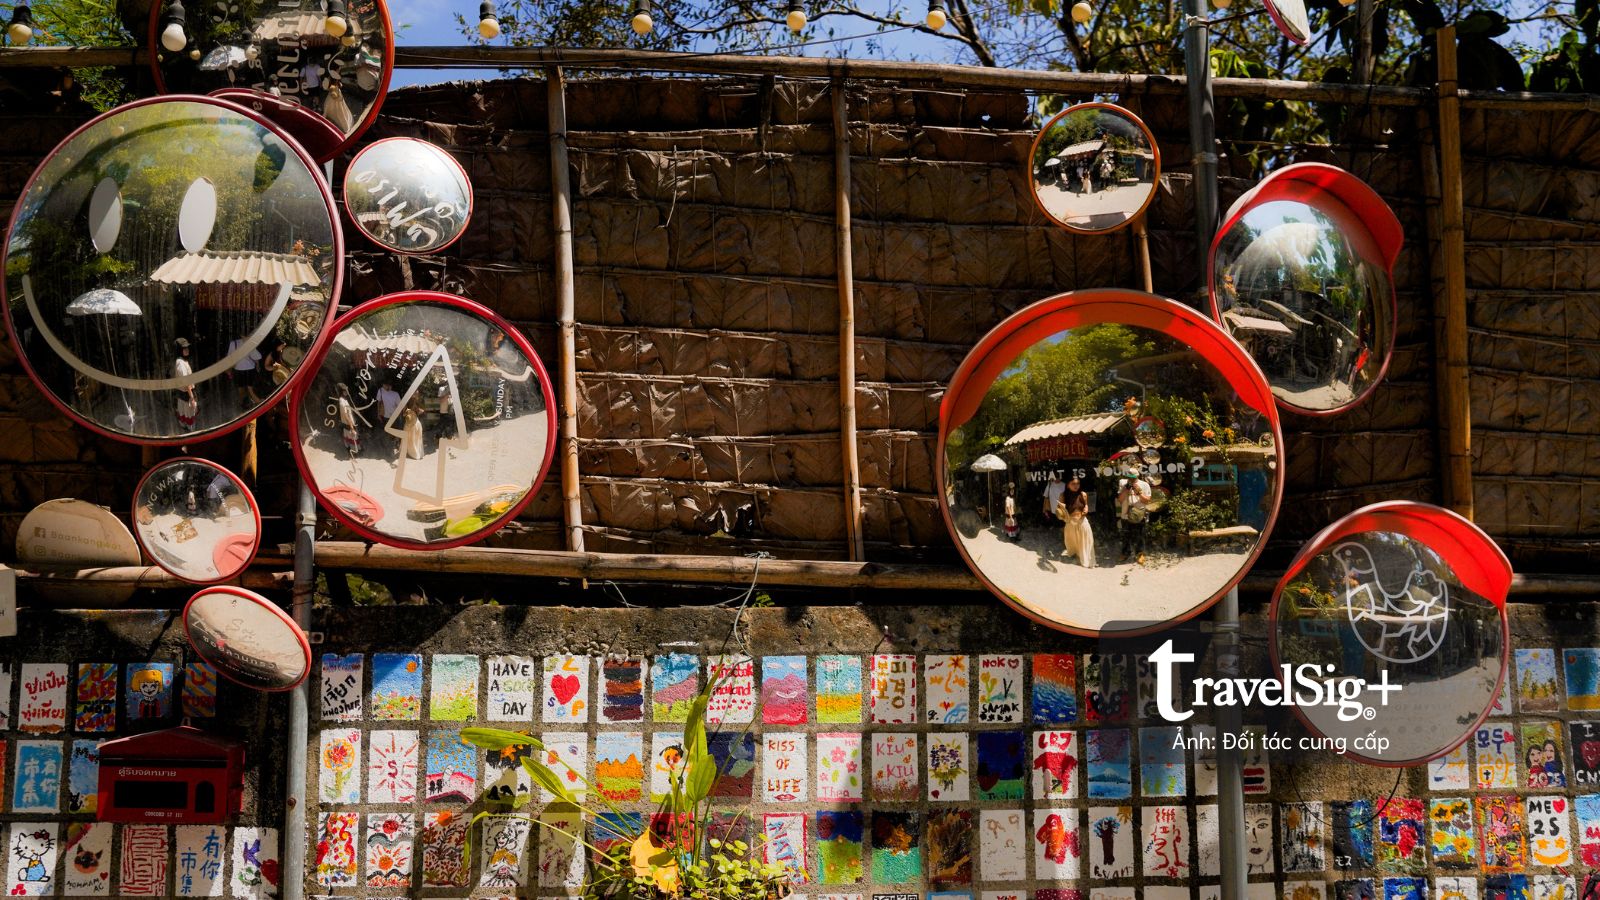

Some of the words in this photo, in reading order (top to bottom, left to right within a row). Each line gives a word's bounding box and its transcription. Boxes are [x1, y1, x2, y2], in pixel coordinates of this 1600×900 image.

[495, 378, 505, 413] SUNDAY
[1026, 469, 1064, 482] WHAT
[1072, 468, 1086, 479] IS
[1094, 465, 1132, 478] YOUR
[1140, 462, 1185, 474] COLOR
[982, 656, 1005, 668] NOK
[493, 663, 530, 677] HAVE
[491, 680, 499, 691] A
[502, 702, 527, 715] DAY
[768, 739, 795, 752] KISS
[388, 760, 398, 778] S
[776, 758, 790, 770] OF
[767, 779, 801, 793] LIFE
[1529, 800, 1552, 814] ME
[200, 829, 221, 880] 有你
